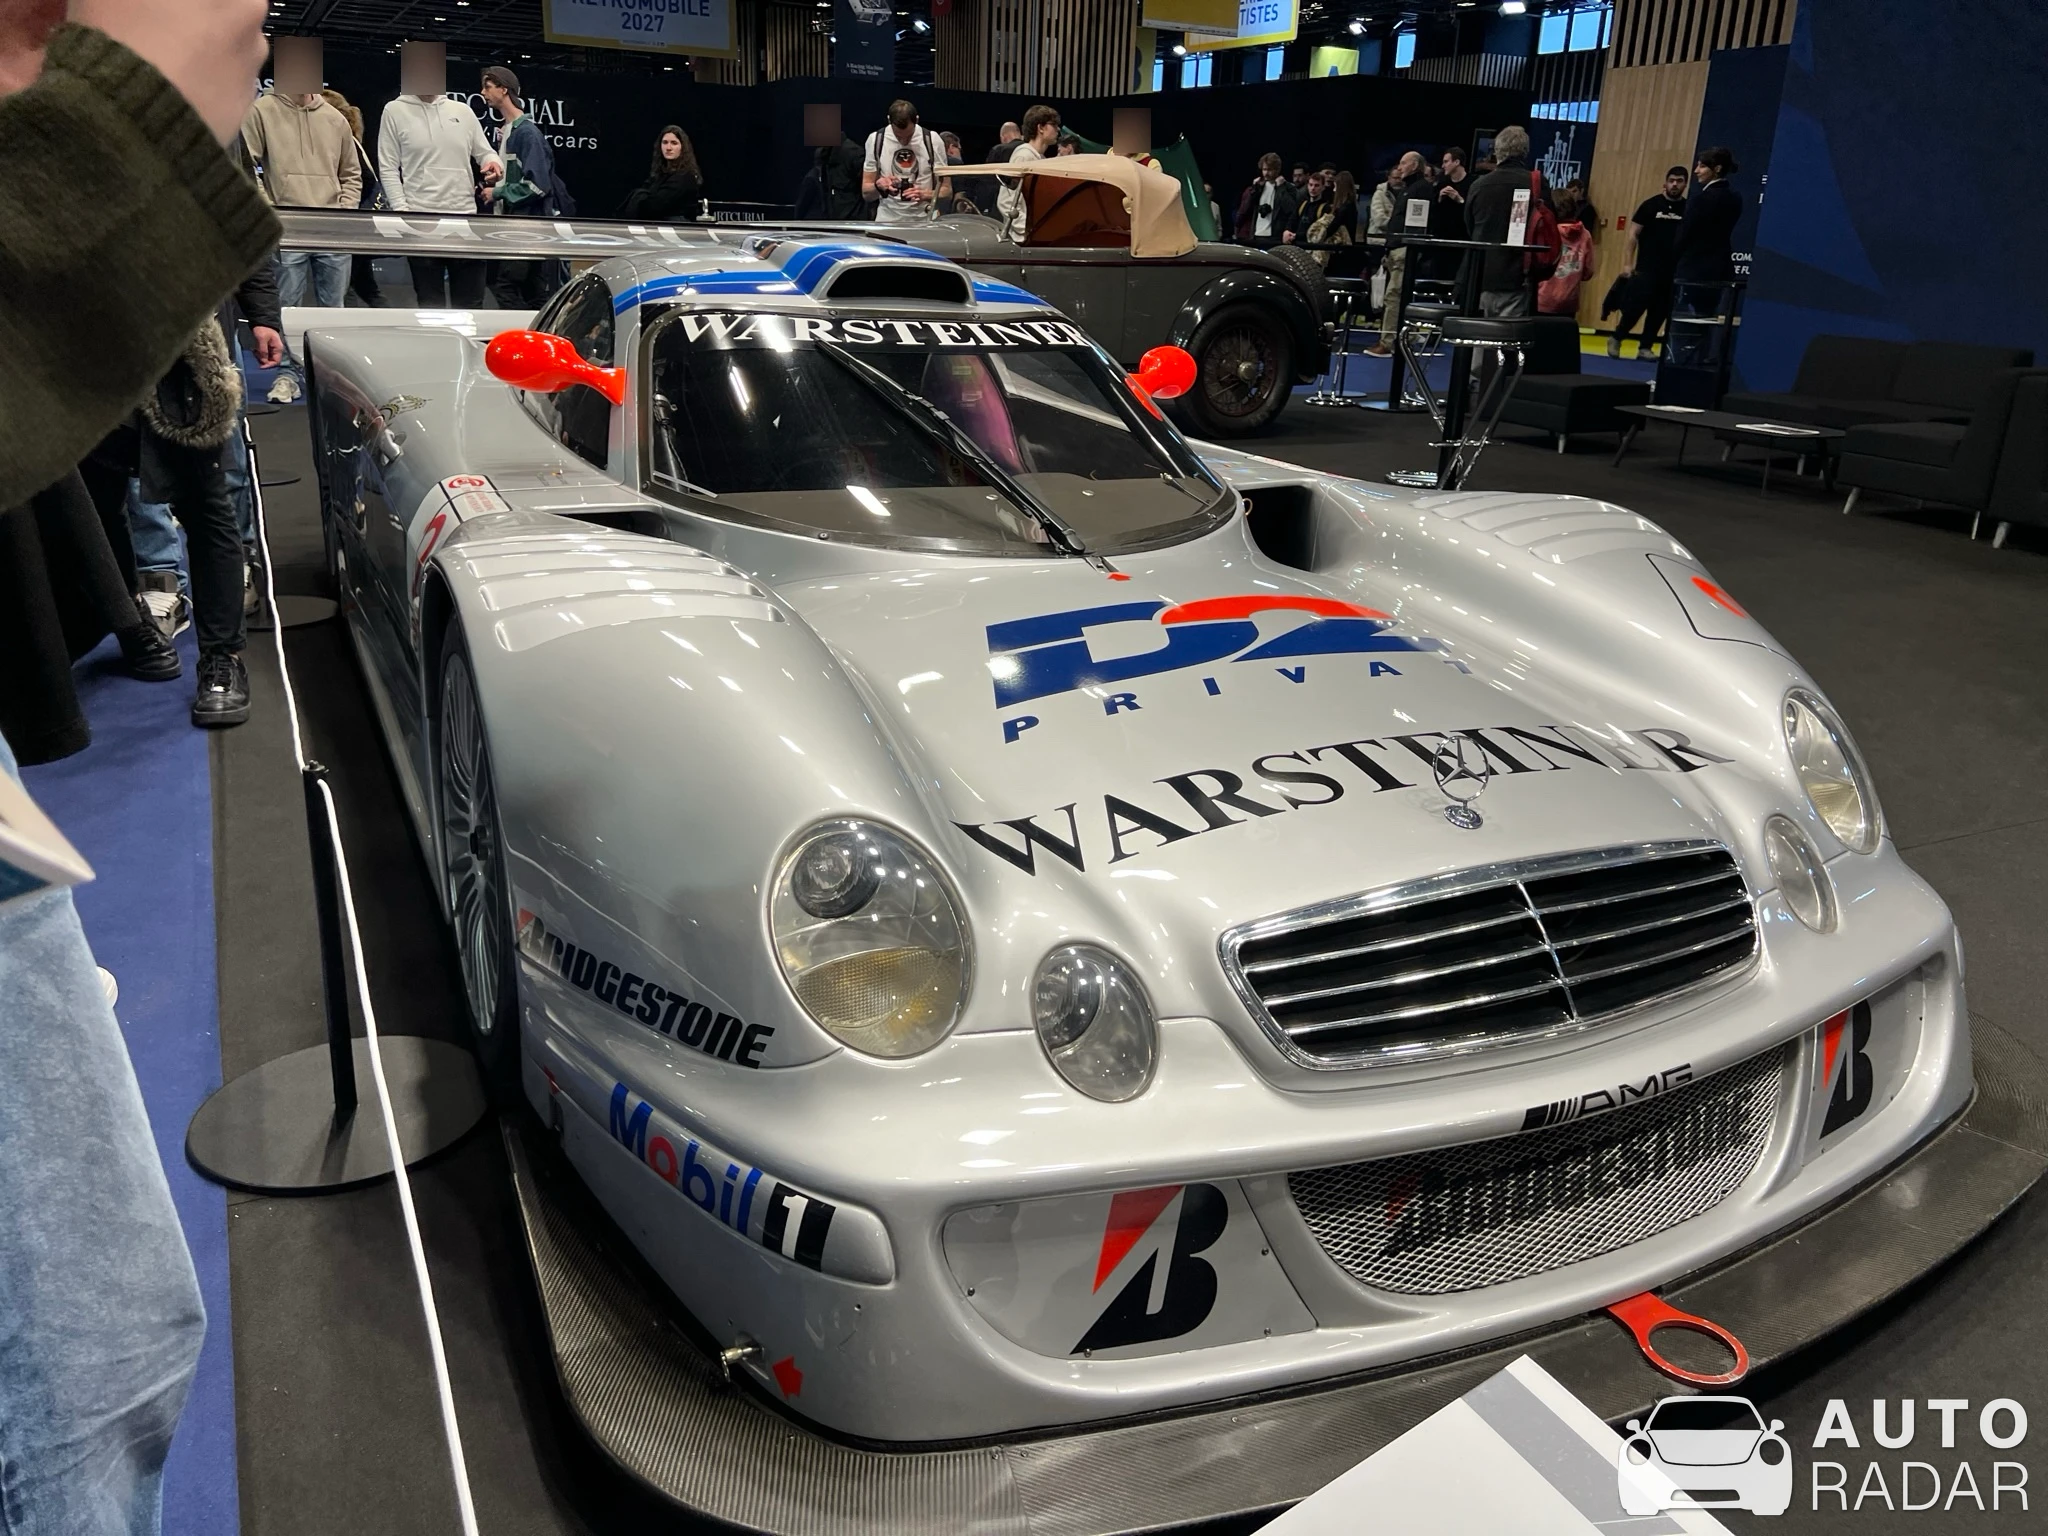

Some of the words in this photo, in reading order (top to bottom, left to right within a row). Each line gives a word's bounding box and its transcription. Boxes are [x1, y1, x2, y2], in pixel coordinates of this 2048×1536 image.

[621, 12, 664, 33] 2027
[678, 314, 1090, 353] WARSTEINER
[985, 595, 1452, 709] D2
[952, 725, 1736, 877] WARSTEINER
[515, 907, 776, 1069] BRIDGESTONE
[609, 1082, 764, 1237] Mobil
